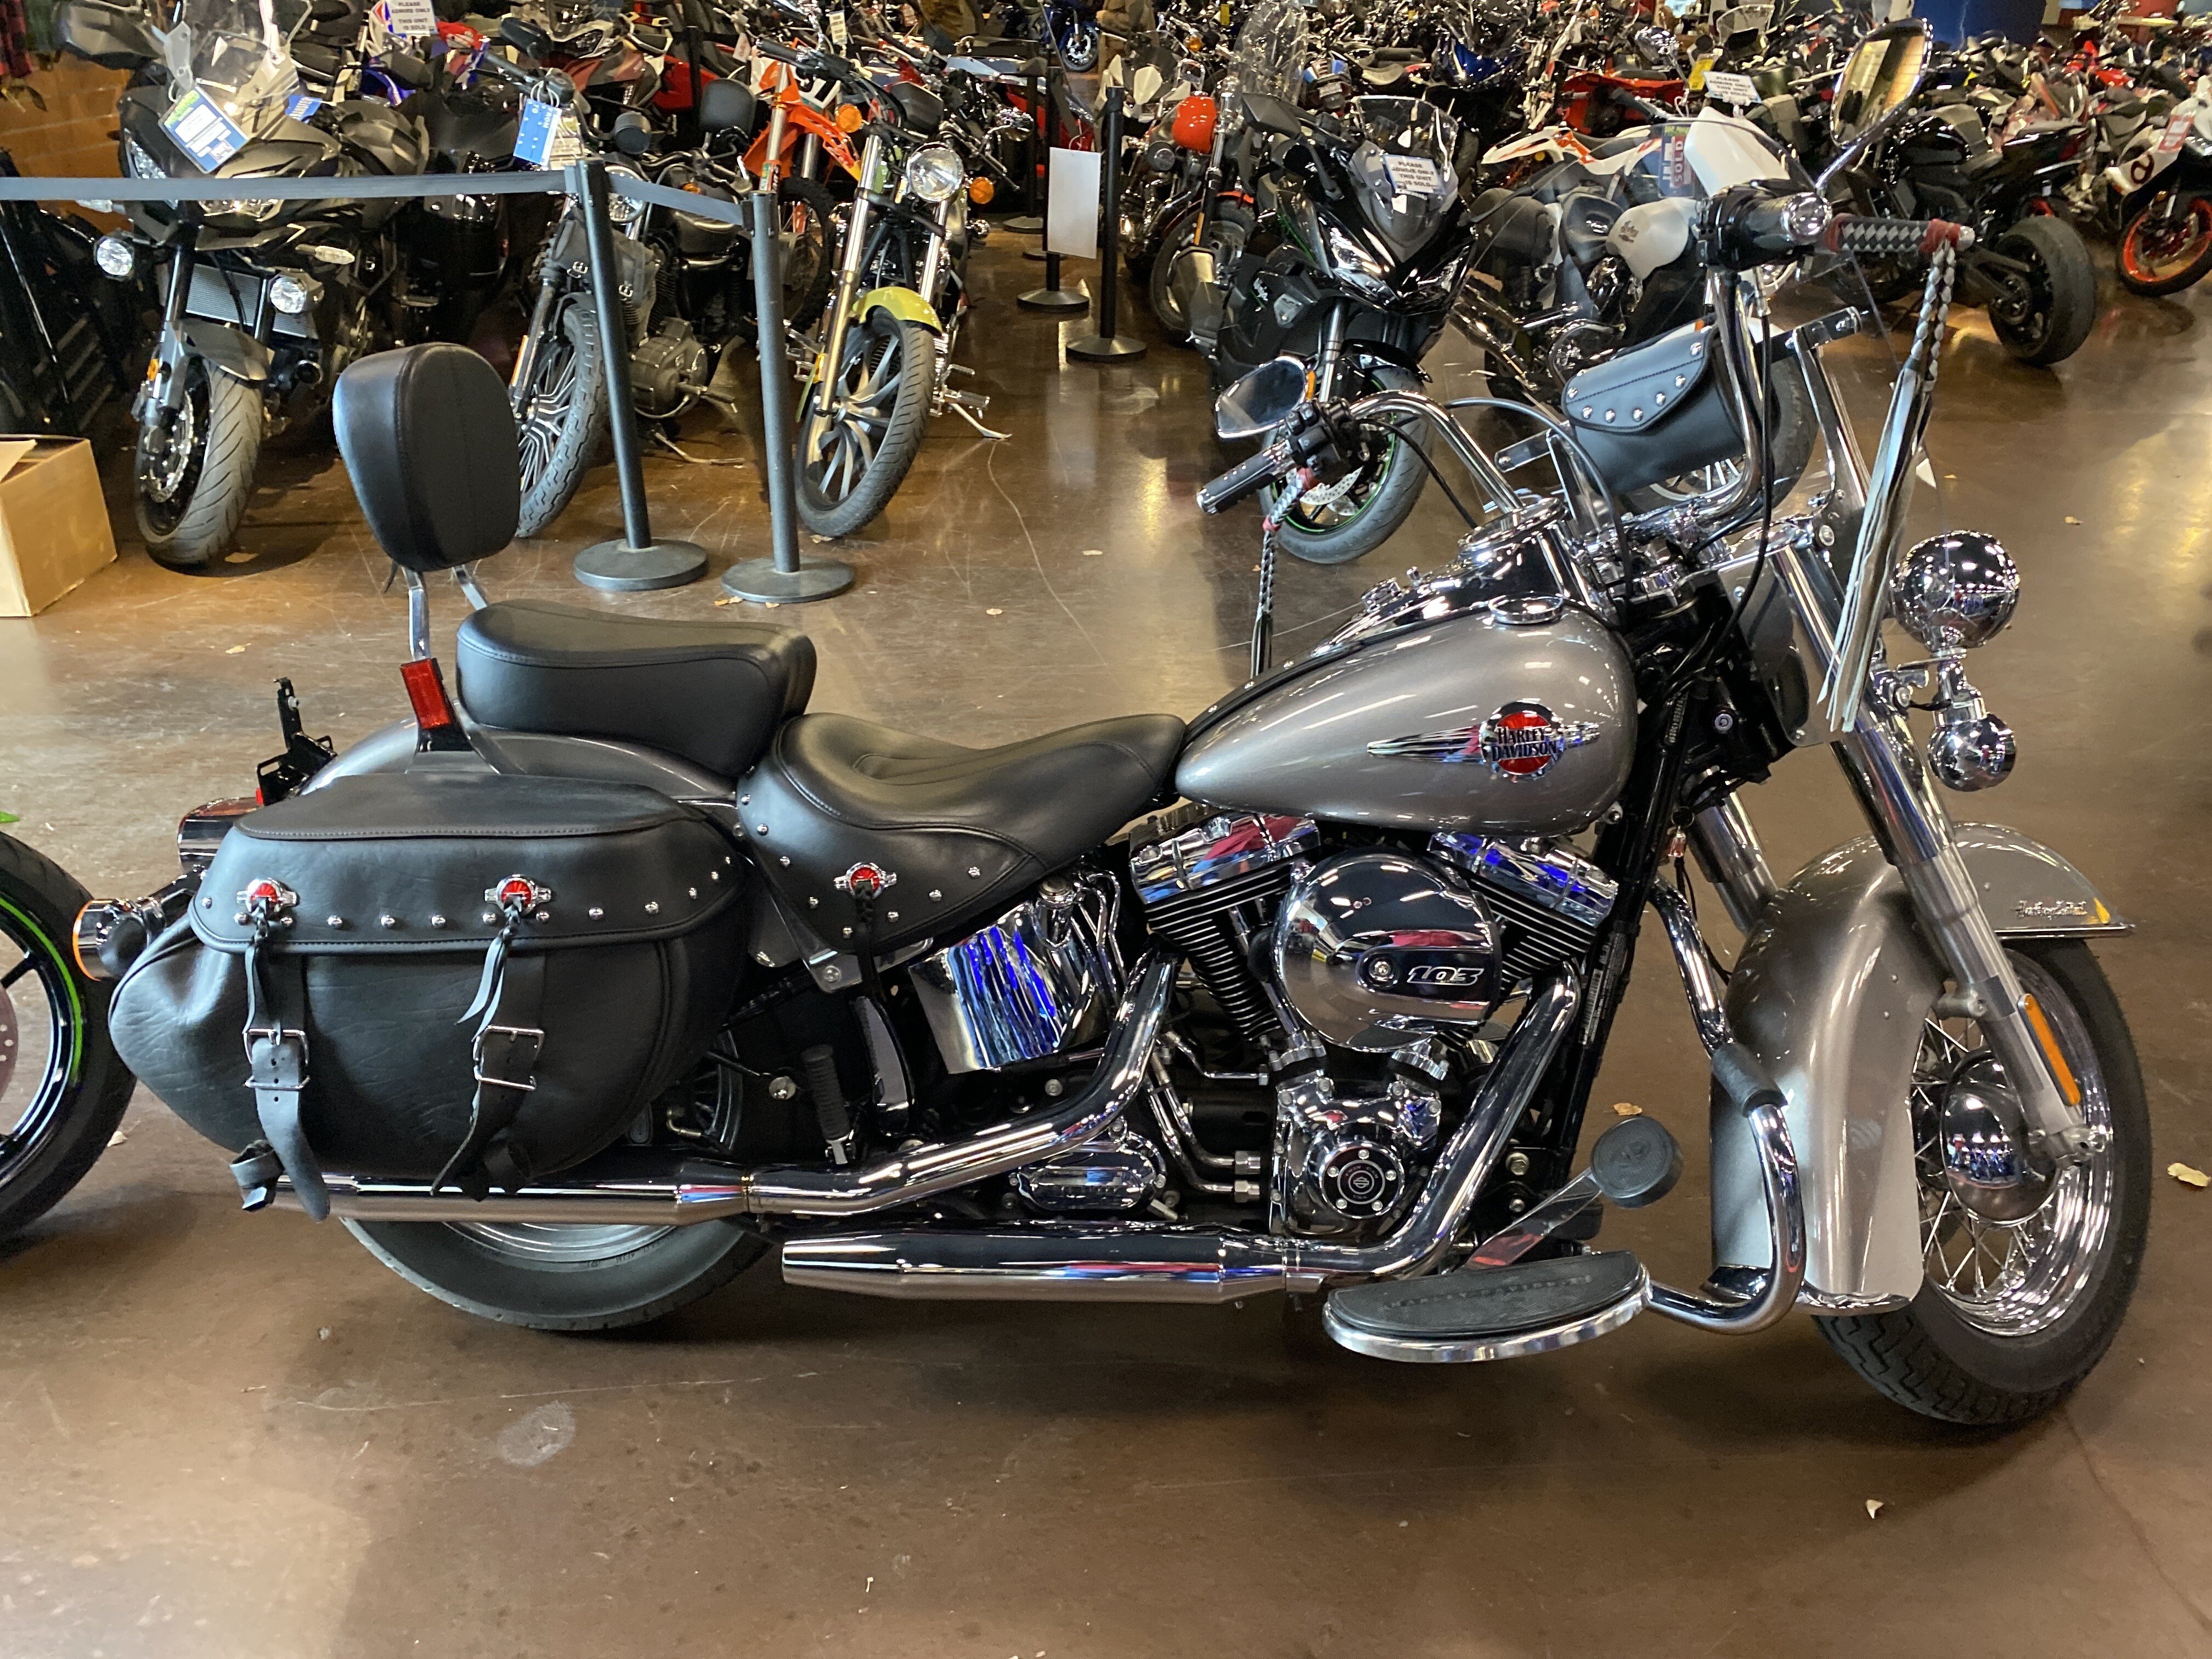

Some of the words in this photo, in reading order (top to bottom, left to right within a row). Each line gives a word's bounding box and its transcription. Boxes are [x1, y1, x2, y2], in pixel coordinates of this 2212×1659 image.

[1674, 140, 1684, 182] SOLD
[1492, 741, 1557, 761] DAVIDSON
[1407, 966, 1485, 986] 103
